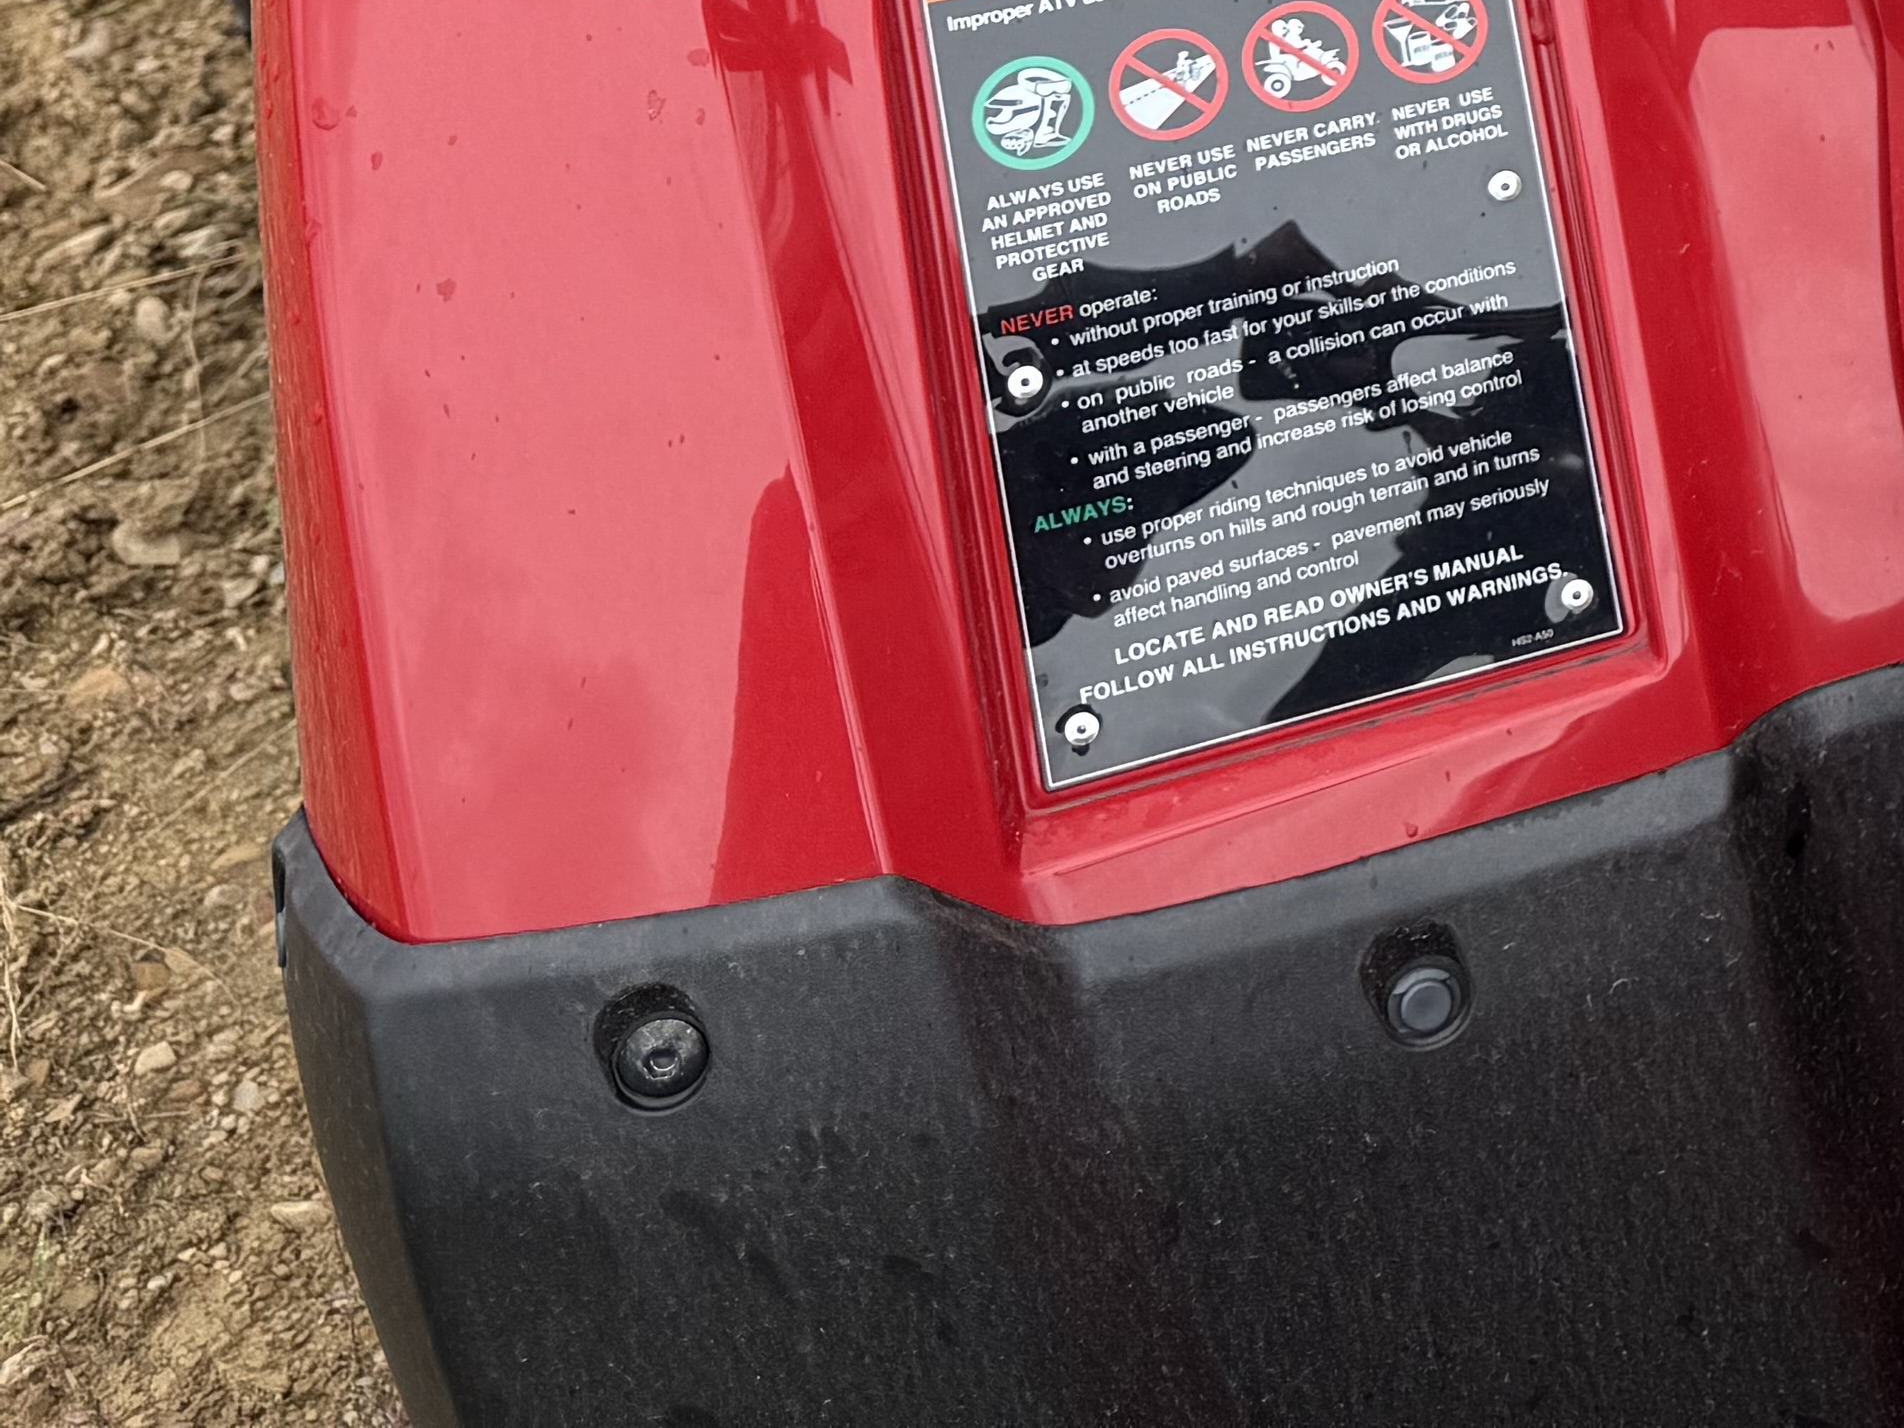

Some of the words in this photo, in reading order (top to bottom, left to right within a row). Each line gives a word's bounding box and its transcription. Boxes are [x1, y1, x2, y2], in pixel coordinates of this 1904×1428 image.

[946, 3, 1034, 32] Improper
[1391, 96, 1451, 121] NEVER
[1458, 86, 1494, 107] USE
[1393, 118, 1439, 140] WITH
[1440, 104, 1503, 131] DRUGS
[1246, 127, 1309, 153] NEVER
[1254, 132, 1376, 172] PASSENGERS
[1395, 142, 1422, 160] OR
[1425, 123, 1509, 154] ALCOHOL
[1129, 154, 1193, 180] NEVER
[1196, 144, 1236, 165] USE
[1133, 180, 1162, 199] ON
[1167, 163, 1238, 192] PUBLIC
[981, 213, 1008, 233] AN
[1012, 191, 1112, 226] APPROVED
[987, 181, 1065, 211] ALWAYS
[1067, 172, 1106, 193] USE
[1156, 187, 1221, 214] ROADS
[991, 221, 1065, 251] HELMET
[1069, 212, 1108, 234] AND
[995, 231, 1110, 270] PROTECTIVE
[1032, 258, 1085, 281] GEAR
[1000, 304, 1074, 335] NEVER
[1079, 288, 1158, 319] operate:
[1069, 317, 1139, 347] without
[1142, 303, 1204, 334] proper
[1207, 287, 1278, 314] training
[1281, 280, 1307, 299] or
[1305, 259, 1399, 297] instruction
[1072, 359, 1091, 378] at
[1095, 343, 1165, 375] speeds
[1168, 337, 1199, 354] too
[1203, 324, 1239, 346] fast
[1242, 319, 1268, 336] for
[1271, 308, 1314, 335] your
[1317, 296, 1367, 320] skills
[1364, 291, 1387, 308] or
[1390, 284, 1420, 302] the
[1425, 261, 1516, 294] conditions
[1077, 392, 1104, 410] on
[1115, 376, 1175, 405] public
[1187, 358, 1244, 383] roads
[1268, 350, 1282, 365] a
[1285, 330, 1366, 360] collision
[1368, 320, 1406, 340] can
[1410, 305, 1464, 330] occur
[1469, 294, 1508, 315] with
[1082, 403, 1159, 434] another
[1163, 385, 1234, 413] vehicle
[1087, 443, 1128, 466] with
[1133, 441, 1146, 455] a
[1150, 415, 1250, 455] passenger
[1273, 383, 1383, 424] passengers
[1386, 367, 1438, 394] affect
[1441, 351, 1514, 379] balance
[1093, 465, 1130, 490] and
[1134, 449, 1212, 480] steering
[1216, 436, 1252, 460] and
[1257, 419, 1336, 449] increase
[1341, 408, 1375, 428] risk
[1378, 399, 1396, 420] of
[1400, 389, 1456, 414] losing
[1460, 369, 1523, 399] control
[1101, 525, 1137, 546] use
[1141, 508, 1203, 540] proper
[1209, 495, 1261, 518] riding
[1265, 468, 1368, 504] techniques
[1371, 462, 1390, 478] to
[1395, 444, 1445, 472] avoid
[1447, 430, 1512, 458] vehicle
[1034, 495, 1134, 533] ALWAYS:
[1104, 536, 1195, 570] overturns
[1200, 528, 1225, 545] on
[1229, 516, 1267, 538] hills
[1272, 504, 1307, 527] and
[1311, 491, 1365, 517] rough
[1369, 476, 1429, 503] terrain
[1433, 462, 1469, 487] and
[1472, 460, 1490, 476] in
[1493, 448, 1541, 471] turns
[1109, 576, 1161, 603] avoid
[1166, 560, 1224, 593] paved
[1229, 542, 1309, 573] surfaces
[1331, 510, 1423, 550] pavement
[1426, 501, 1466, 523] may
[1469, 478, 1550, 512] seriously
[1114, 600, 1167, 628] affect
[1170, 581, 1252, 613] handling
[1256, 566, 1292, 591] and
[1296, 549, 1359, 580] control
[1115, 626, 1206, 665] LOCATE
[1212, 613, 1258, 640] AND
[1263, 596, 1324, 626] READ
[1330, 568, 1429, 608] OWNER'S
[1432, 544, 1524, 581] MANUAL
[1079, 664, 1174, 704] FOLLOW
[1182, 653, 1225, 677] ALL
[1229, 607, 1391, 664] INSTRUCTIONS
[1396, 594, 1442, 621] AND
[1445, 562, 1568, 607] WARNINGS.
